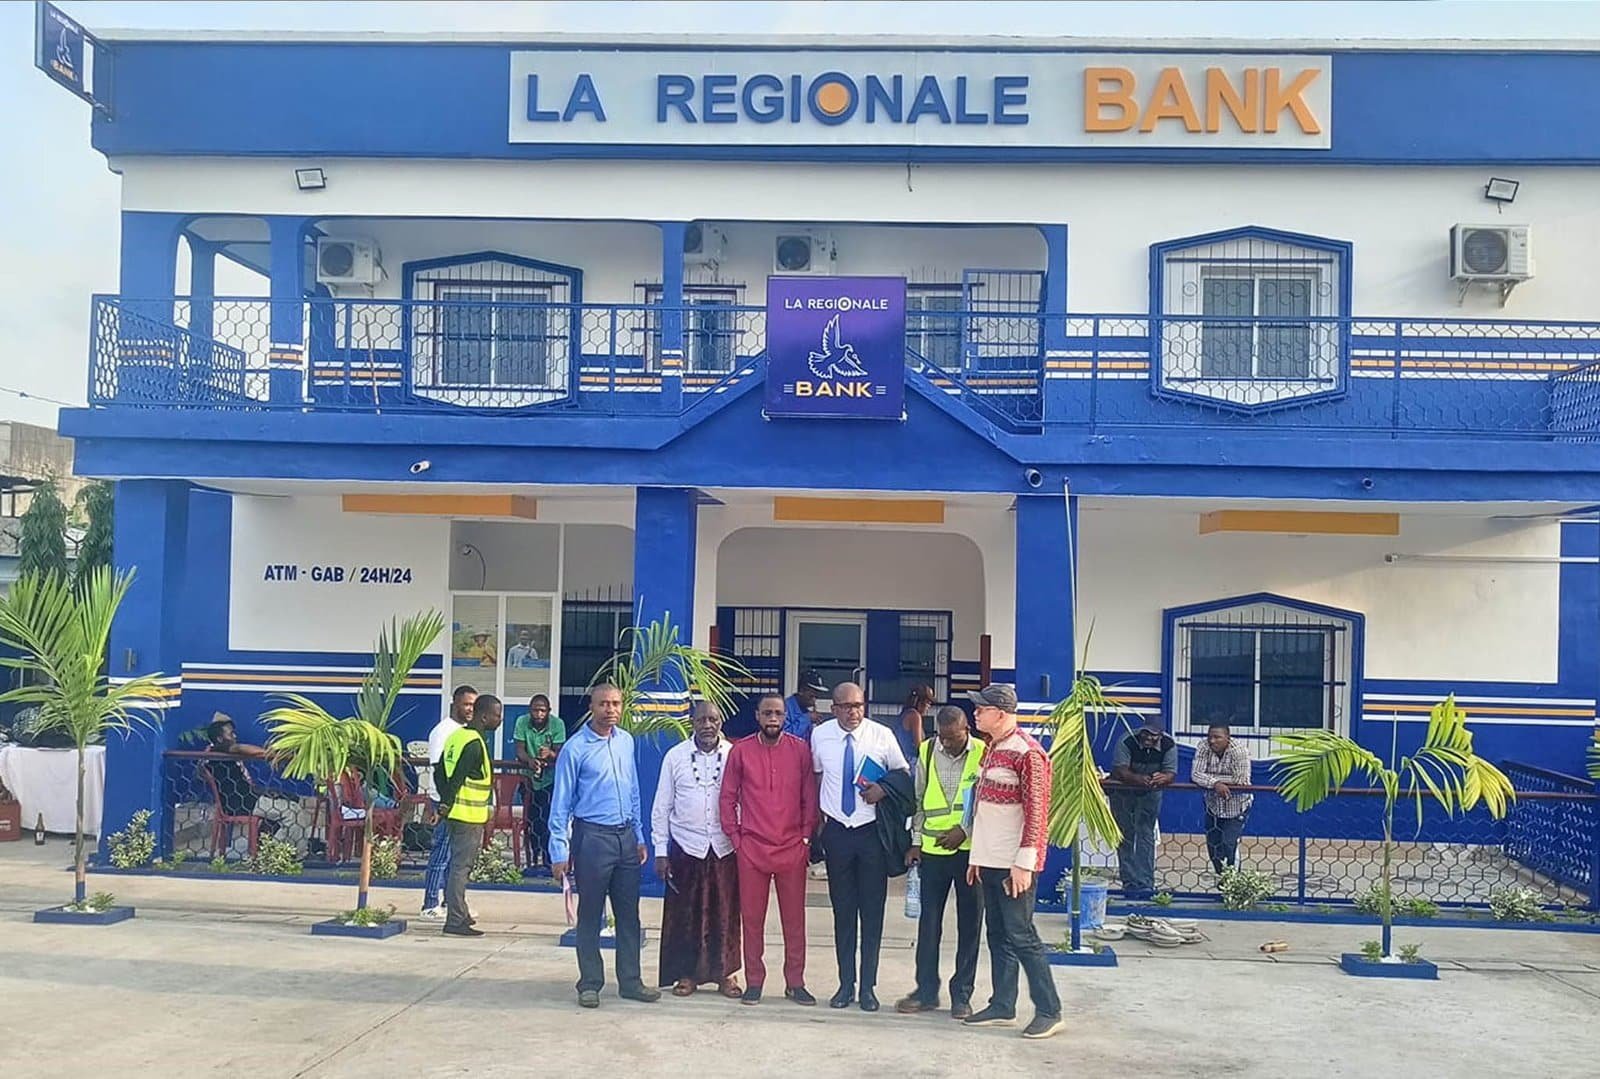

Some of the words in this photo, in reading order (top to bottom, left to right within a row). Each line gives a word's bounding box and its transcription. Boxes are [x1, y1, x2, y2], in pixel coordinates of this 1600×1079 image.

[527, 74, 607, 122] LA
[657, 72, 1029, 126] REGIONALE
[1083, 67, 1322, 135] BANK
[785, 298, 802, 309] LA
[808, 297, 889, 311] REGIONALE
[795, 381, 872, 398] BANK
[264, 565, 297, 581] ATM
[311, 566, 344, 582] GAB
[349, 567, 357, 583] /
[360, 567, 412, 584] 24H/24
